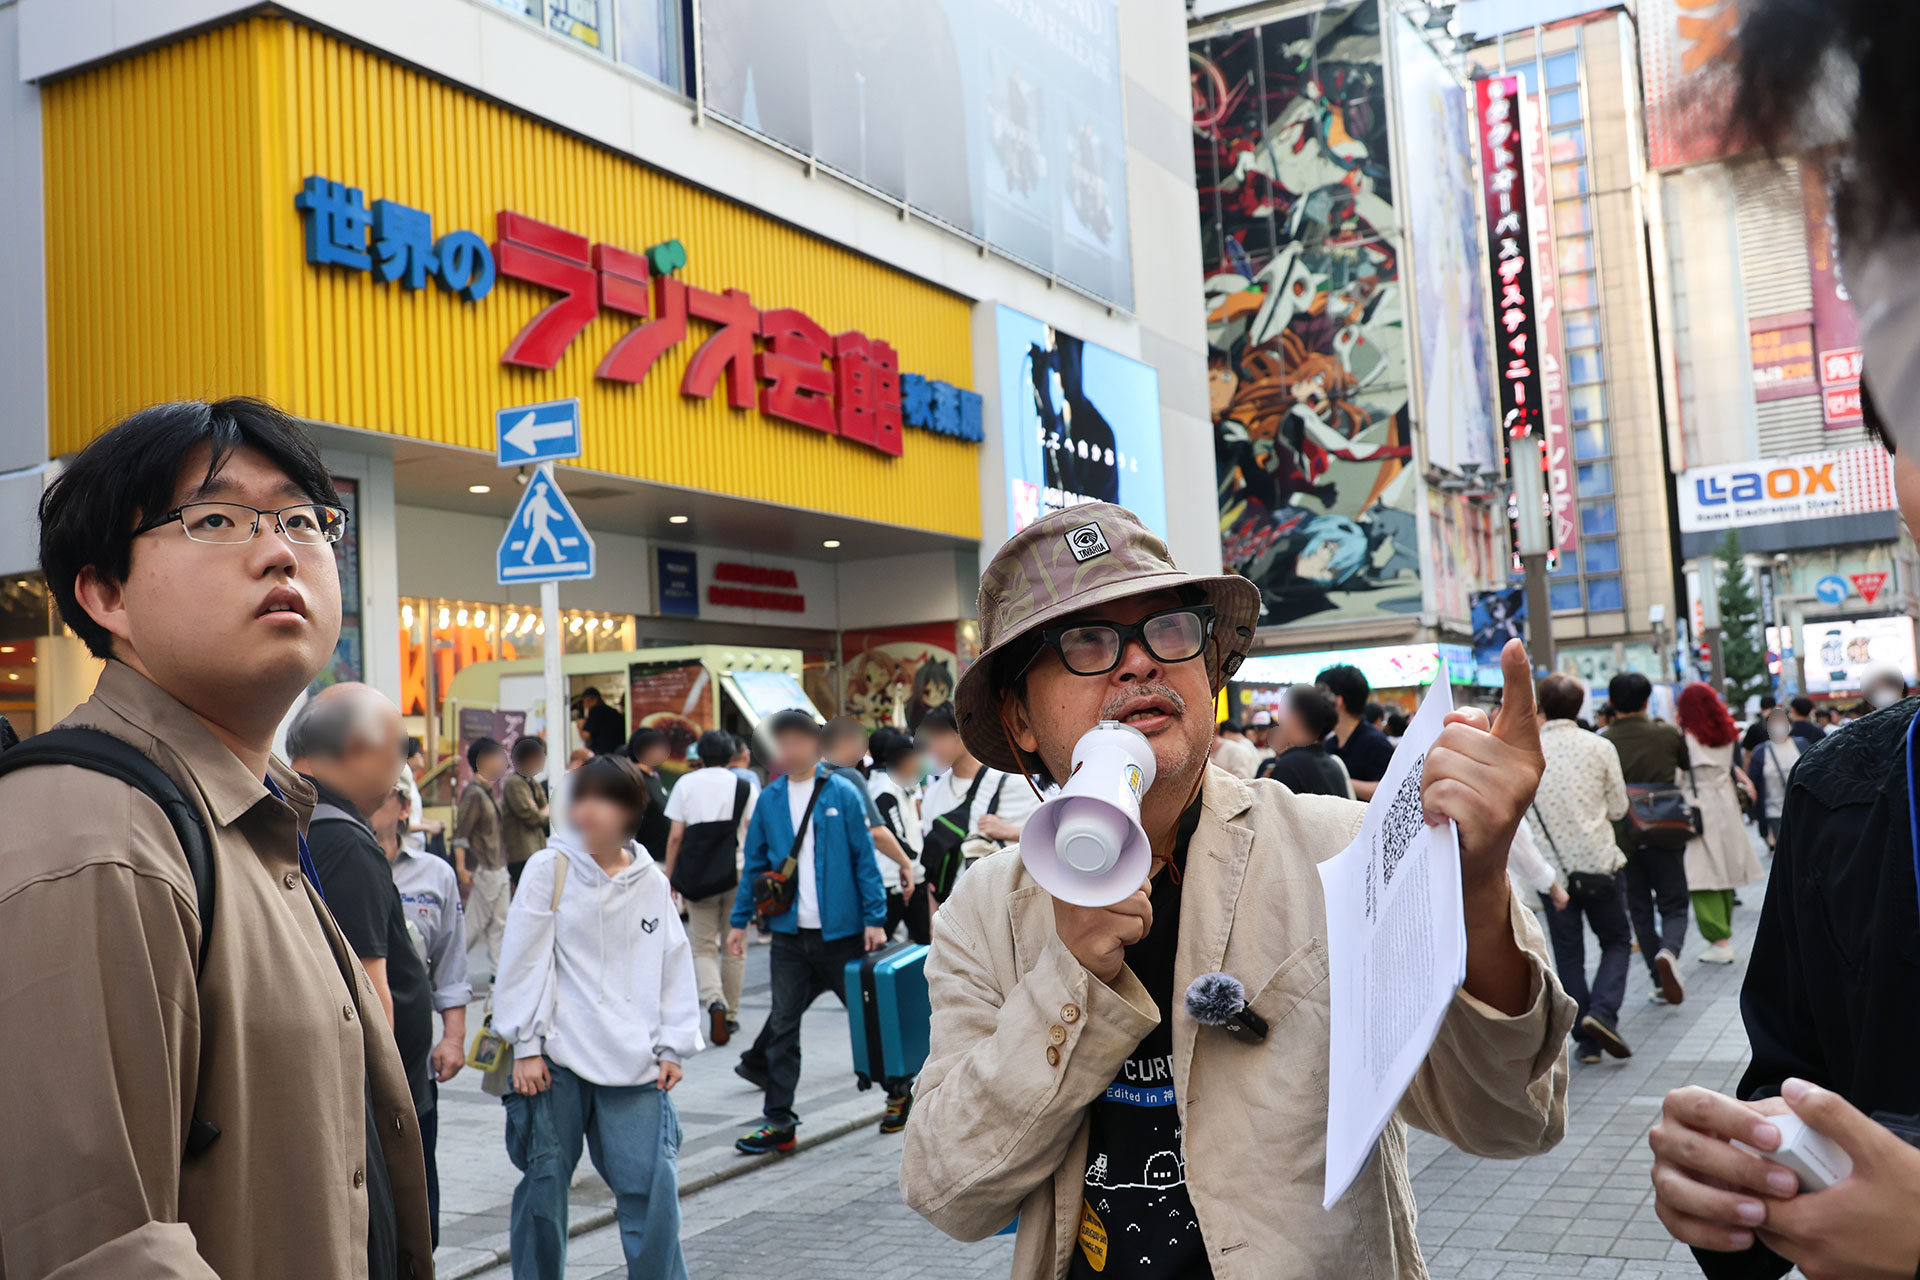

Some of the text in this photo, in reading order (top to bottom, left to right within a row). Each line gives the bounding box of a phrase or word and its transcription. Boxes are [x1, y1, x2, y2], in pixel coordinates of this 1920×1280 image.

[295, 174, 496, 302] 世界の
[491, 210, 904, 457] ラジオ会館
[1077, 543, 1106, 560] TAVARUA
[1106, 1087, 1141, 1103] Edited
[1146, 1093, 1158, 1103] in
